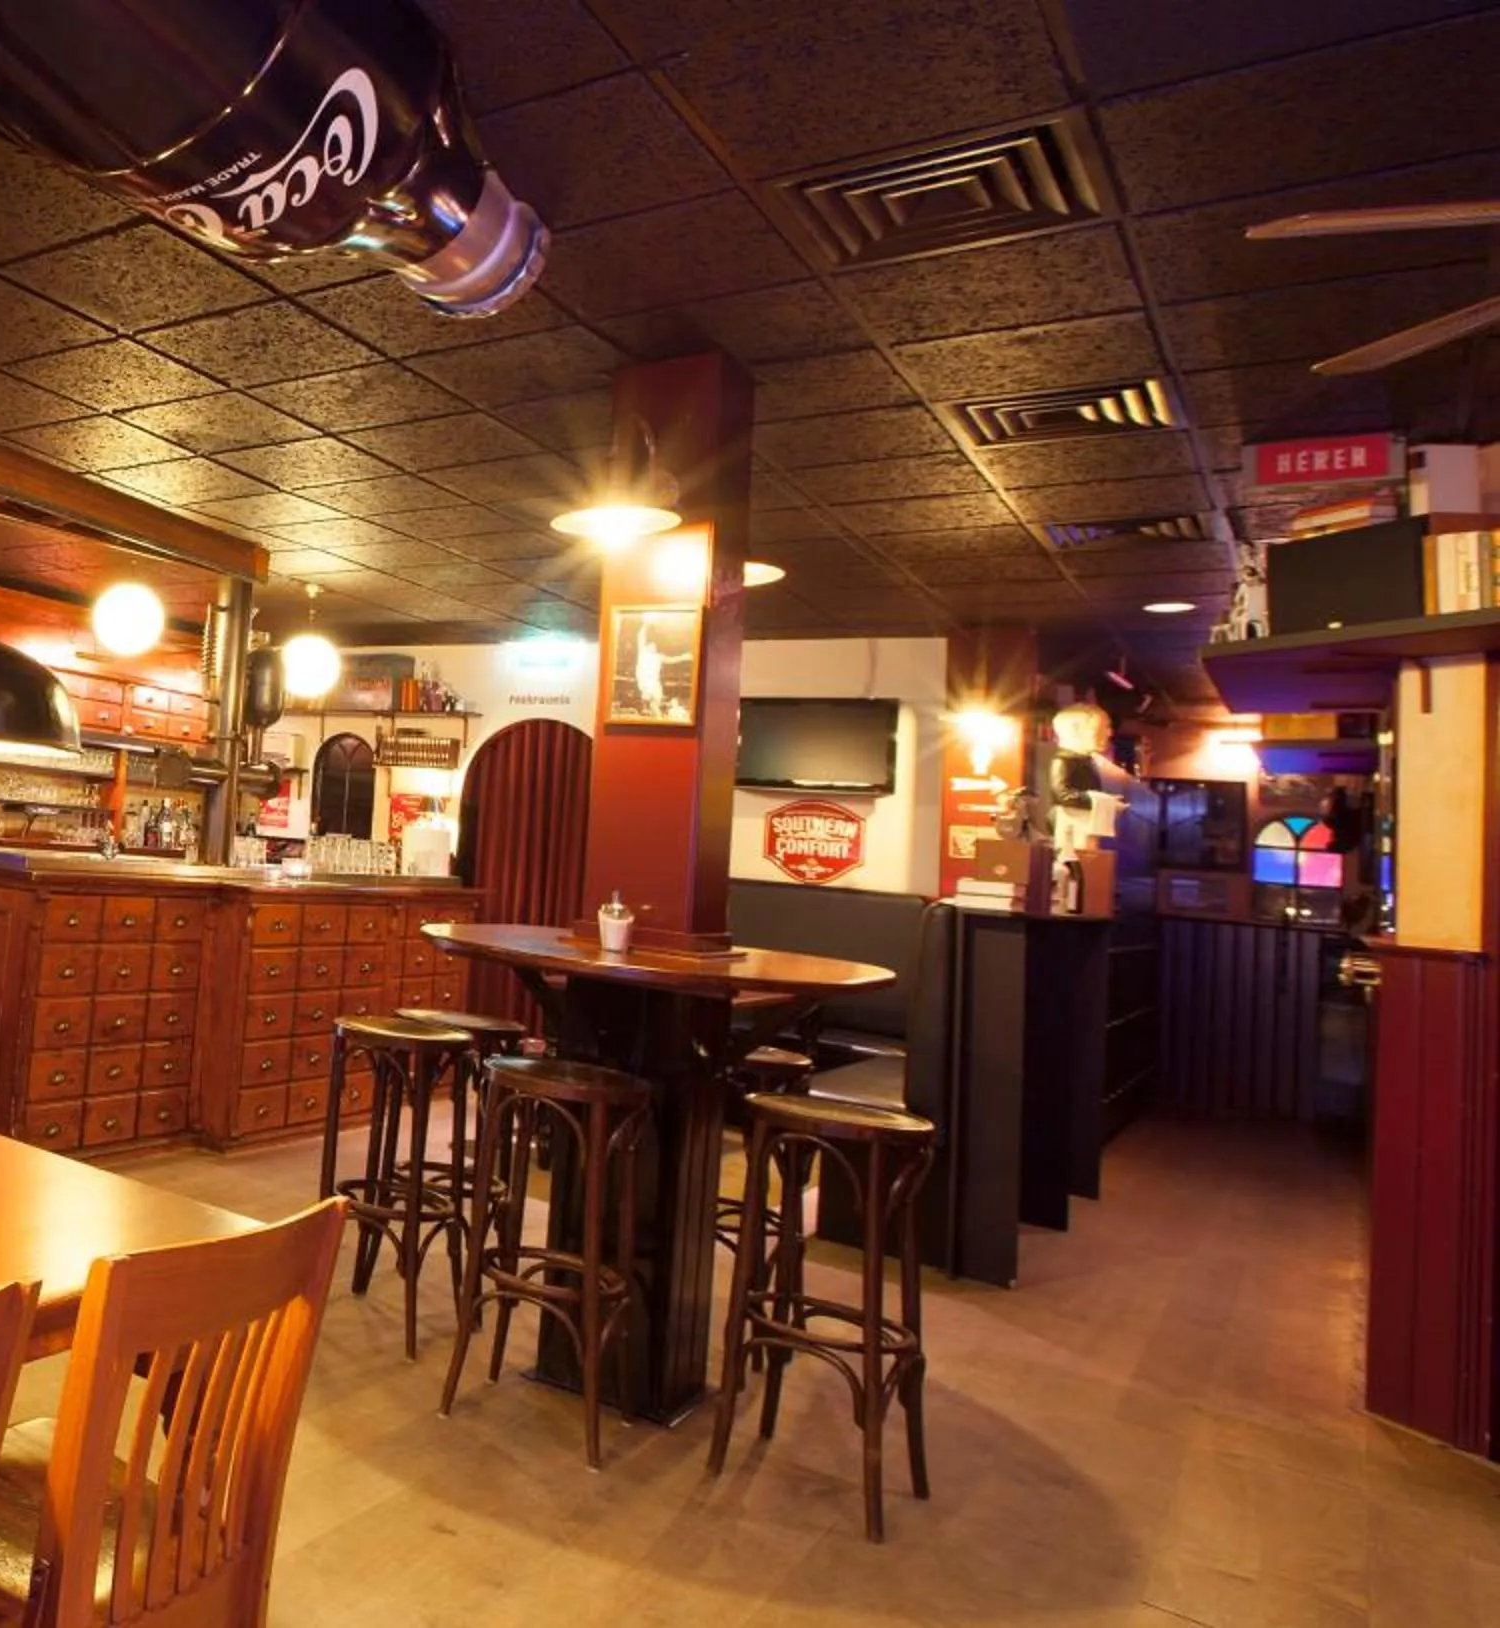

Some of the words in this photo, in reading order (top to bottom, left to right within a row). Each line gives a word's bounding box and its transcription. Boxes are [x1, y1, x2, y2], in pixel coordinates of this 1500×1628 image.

[204, 150, 262, 188] TRADE
[1276, 446, 1368, 475] HEREN
[771, 815, 858, 839] SOUTHERN
[775, 837, 852, 861] COMFORT
